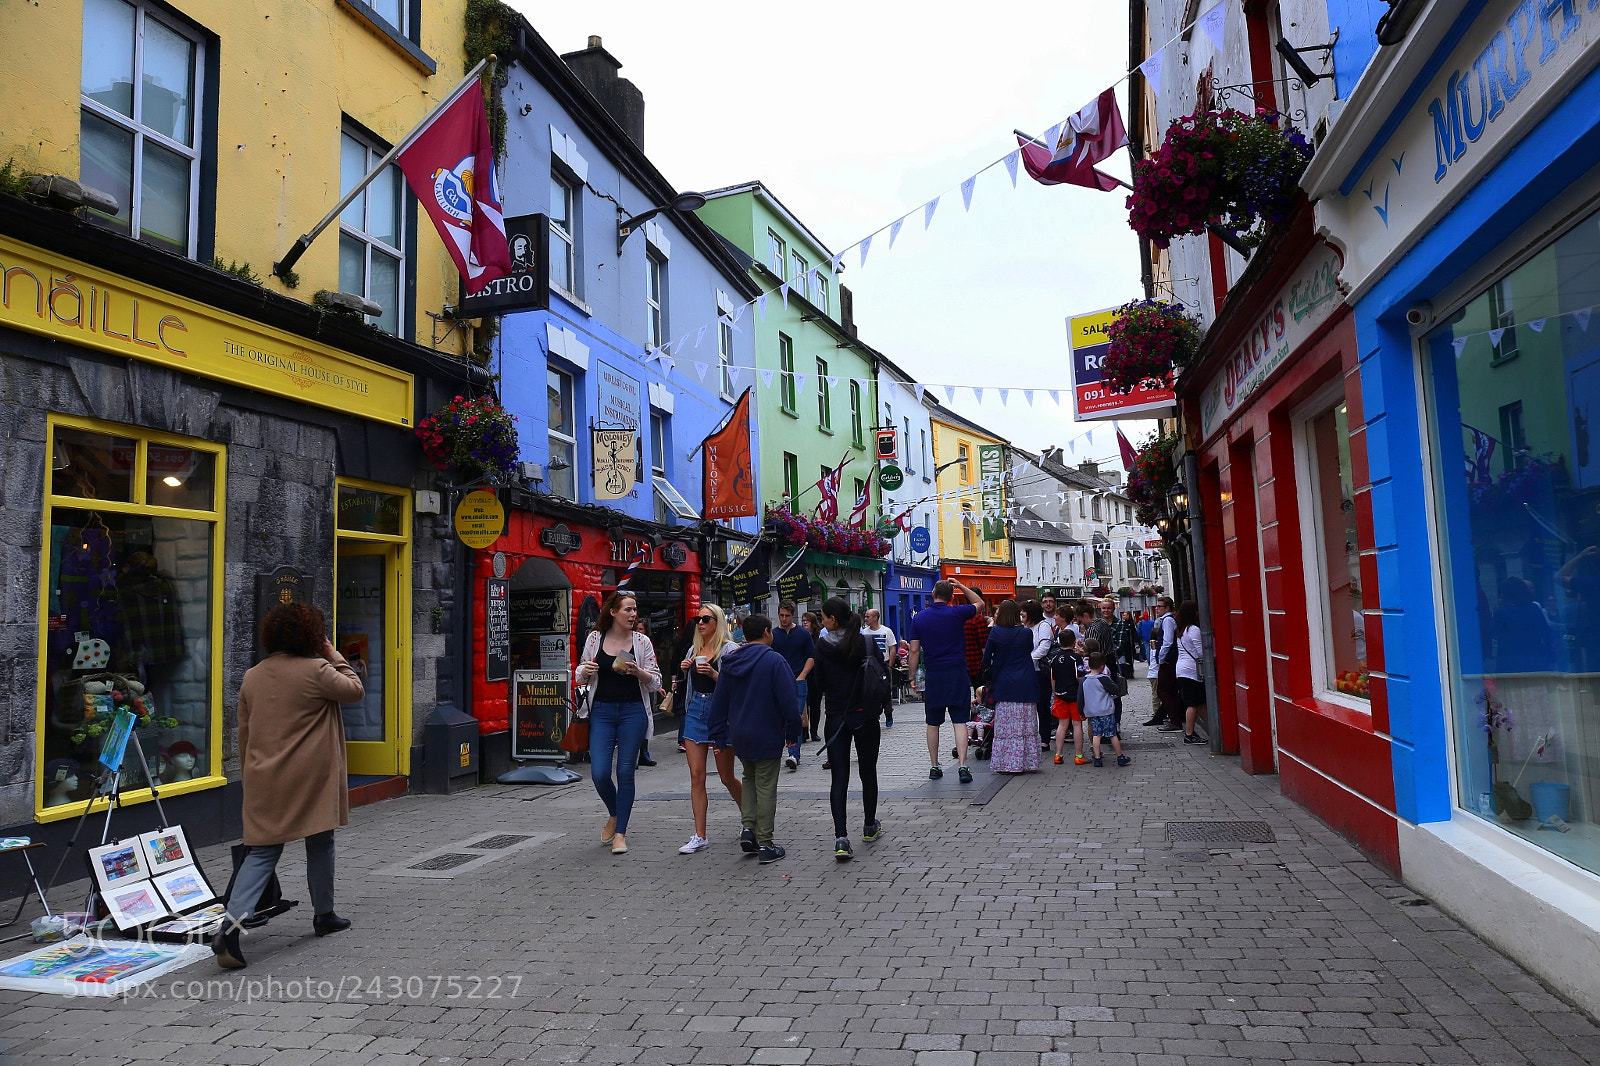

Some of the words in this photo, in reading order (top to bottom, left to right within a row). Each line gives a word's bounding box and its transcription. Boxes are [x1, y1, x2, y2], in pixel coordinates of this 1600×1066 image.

[1427, 0, 1600, 184] MURPH
[224, 341, 245, 358] THE
[248, 349, 298, 372] ORIGINAL
[300, 364, 331, 383] HOUSE
[333, 374, 344, 387] OF
[346, 378, 369, 394] STYLE
[1084, 389, 1105, 400] 091
[709, 445, 718, 503] MOLONEY
[711, 504, 748, 514] MUSIC
[530, 673, 559, 681] UPSTAIRS
[526, 684, 557, 696] Musical
[518, 695, 566, 706] Instruments
